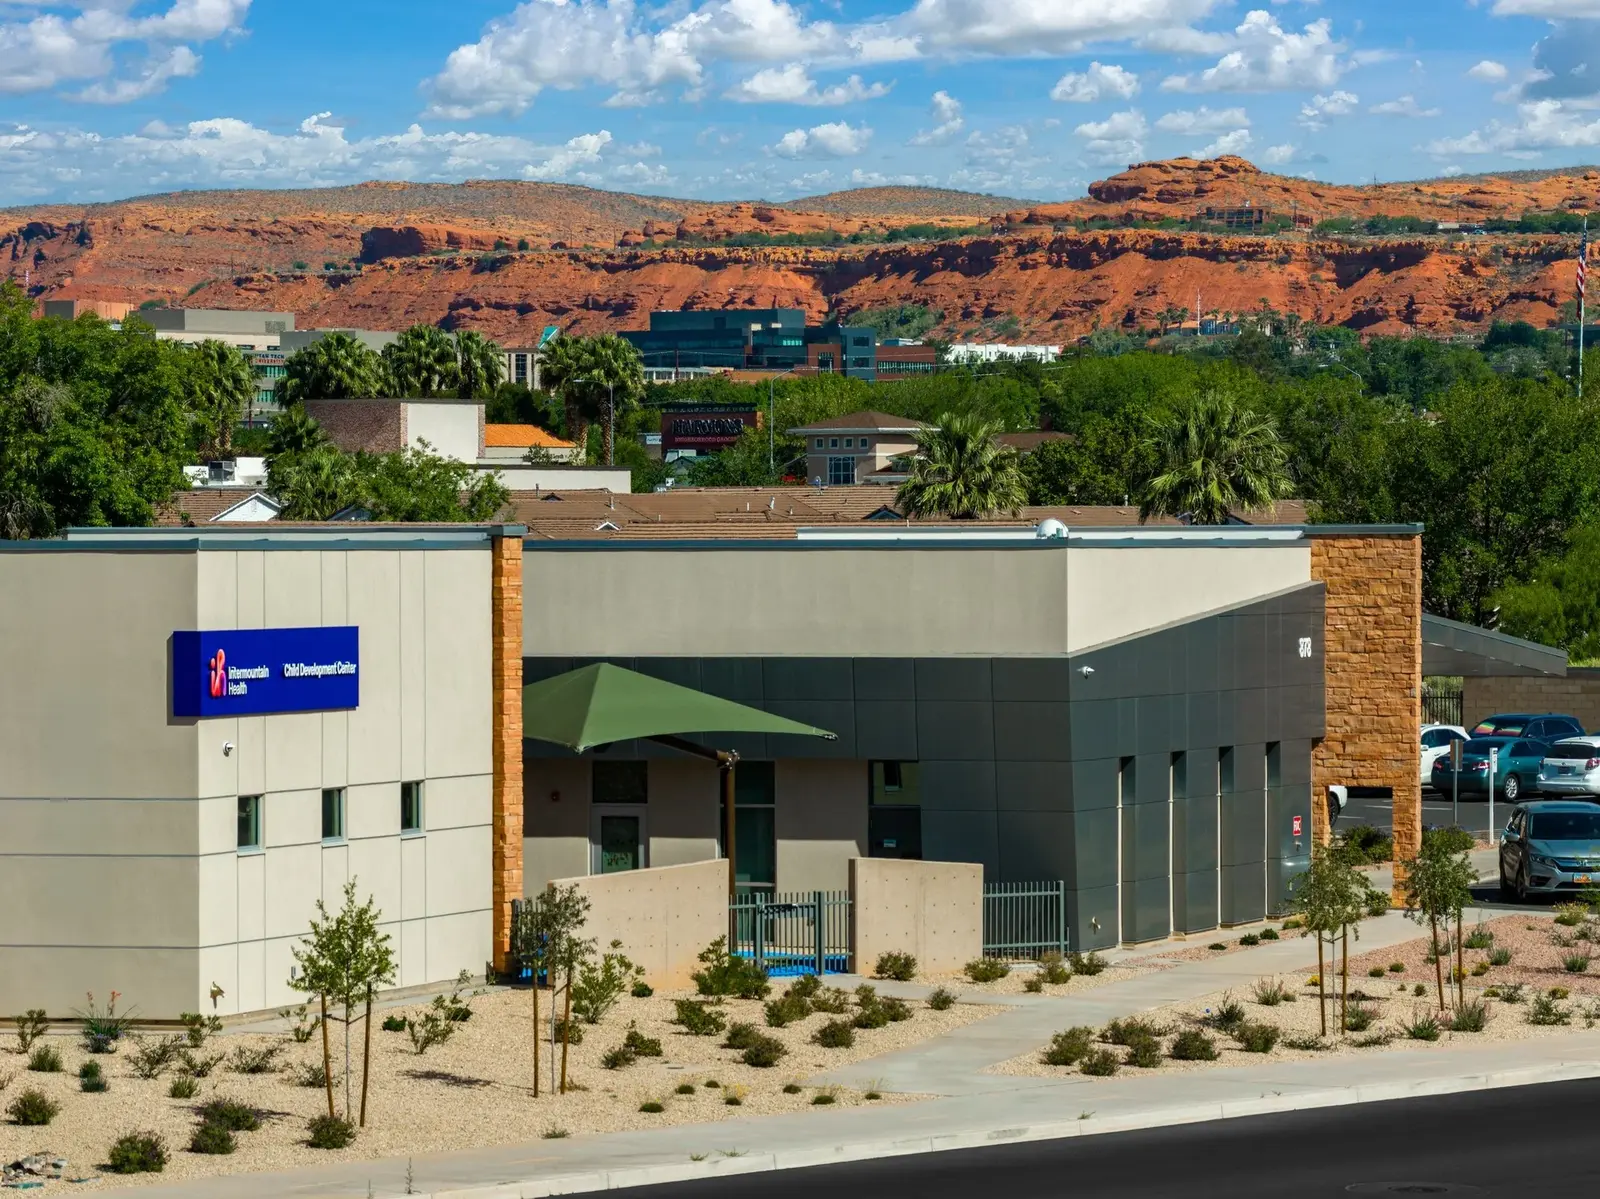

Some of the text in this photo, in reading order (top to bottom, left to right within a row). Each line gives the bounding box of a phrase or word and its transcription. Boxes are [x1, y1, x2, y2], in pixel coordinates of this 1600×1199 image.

[1299, 637, 1311, 658] 878
[228, 665, 270, 679] Intermountain
[284, 660, 357, 678] Child Development Center
[228, 681, 248, 695] Health
